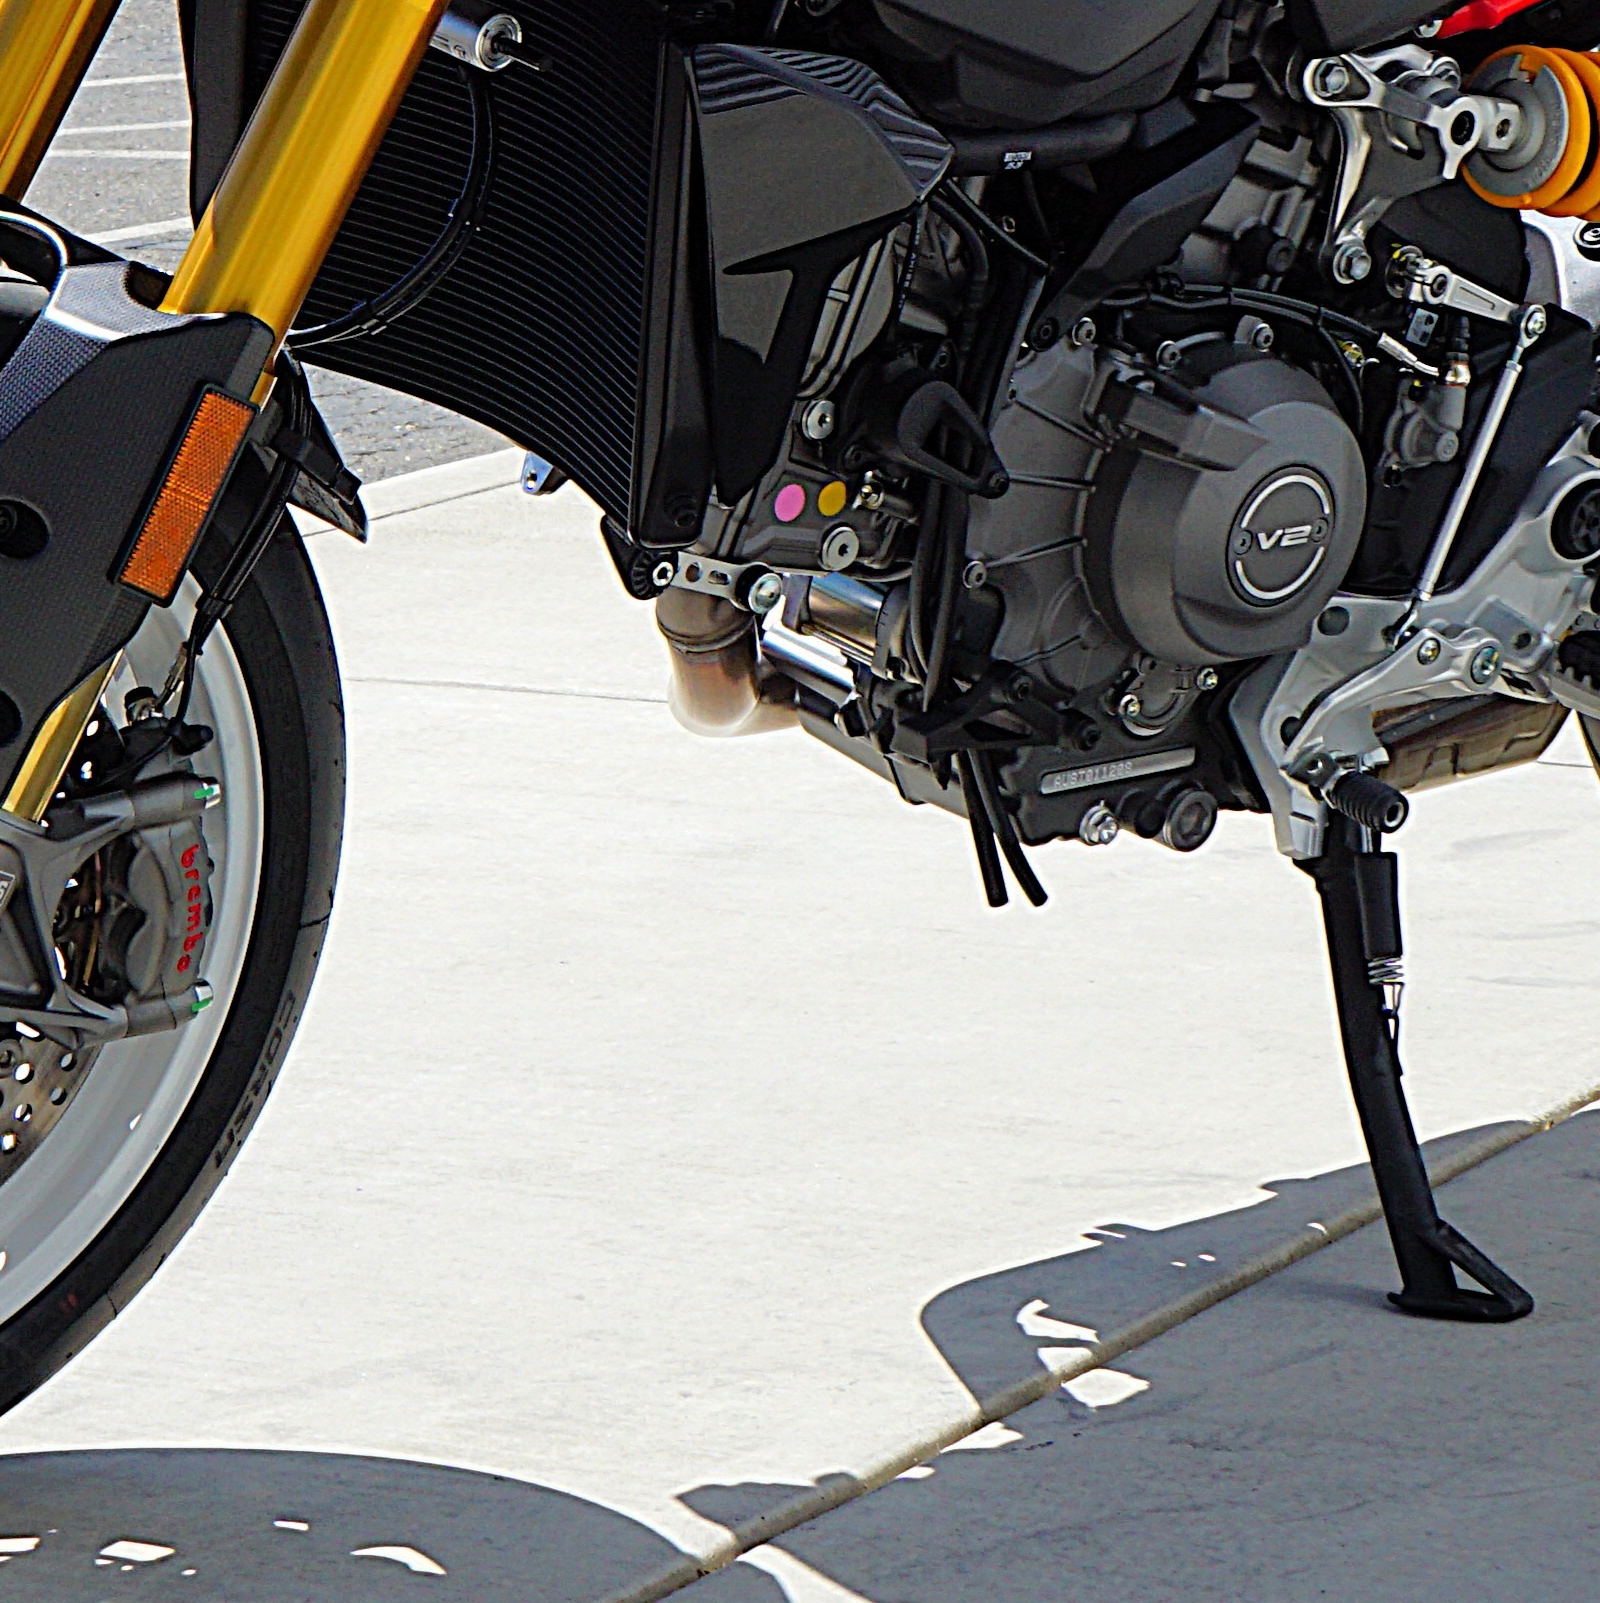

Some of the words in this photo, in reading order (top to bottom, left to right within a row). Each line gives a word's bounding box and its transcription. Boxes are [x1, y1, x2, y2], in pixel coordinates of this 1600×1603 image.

[1257, 524, 1312, 550] V2
[176, 843, 204, 973] brembo
[214, 990, 296, 1170] CORSA
